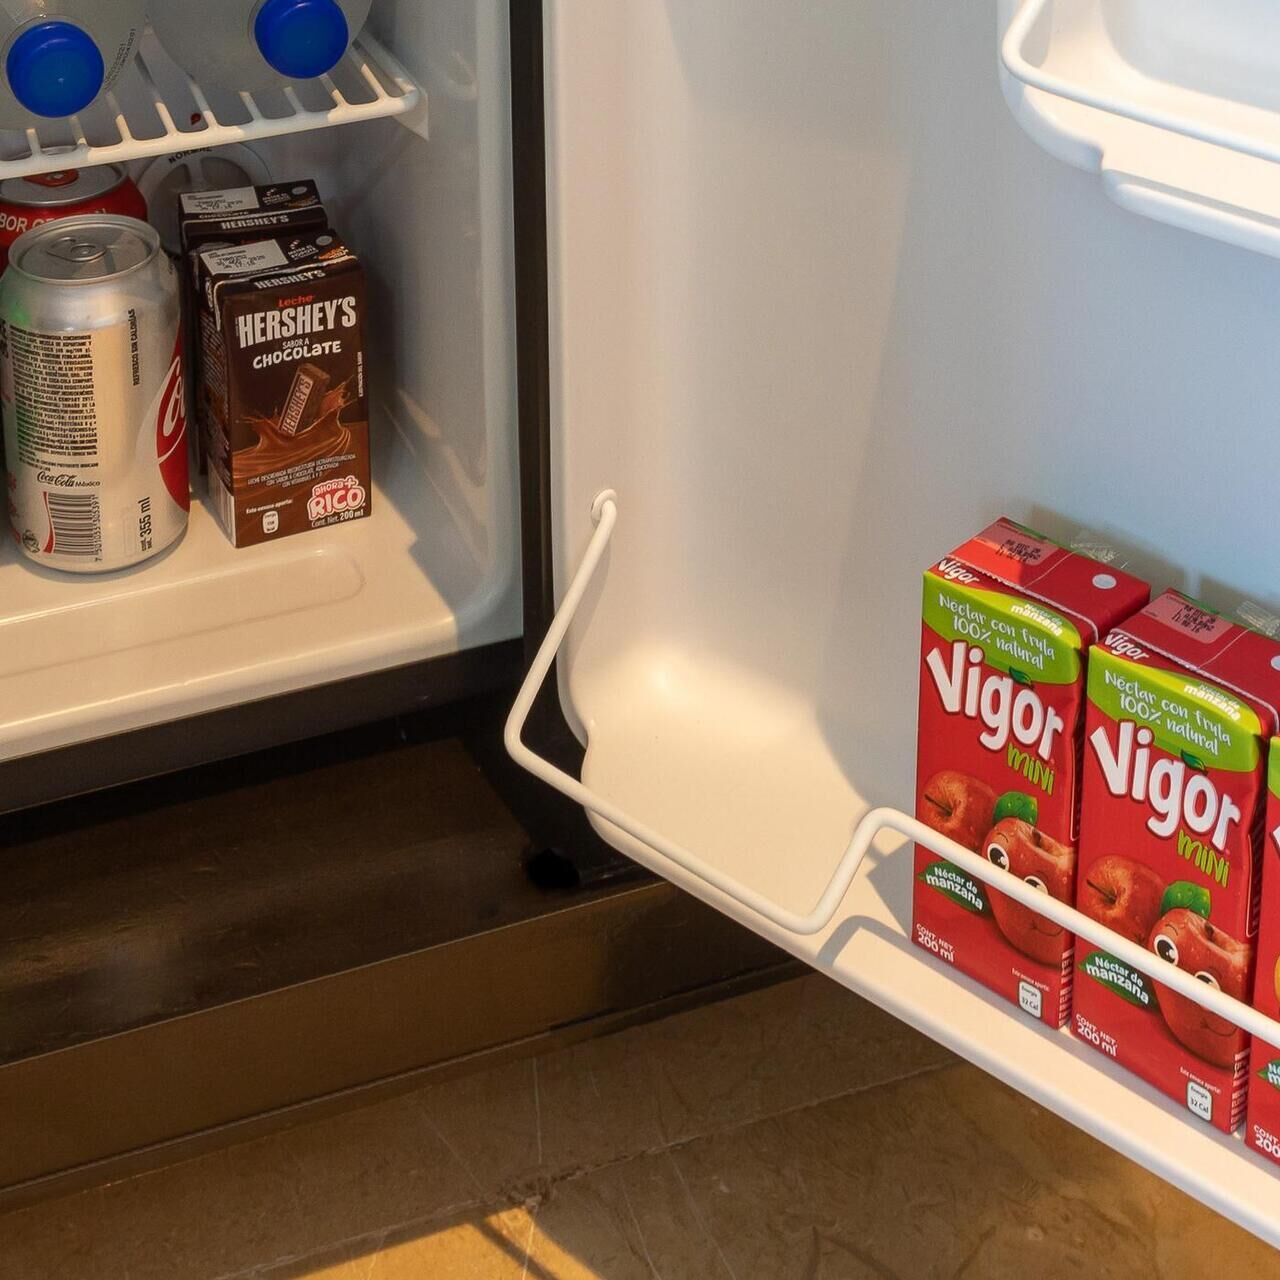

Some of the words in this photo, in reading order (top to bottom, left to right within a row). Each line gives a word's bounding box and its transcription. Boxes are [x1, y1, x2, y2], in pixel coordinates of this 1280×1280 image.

[220, 214, 290, 230] HERSHEY'S
[253, 269, 327, 289] HERSHEY'S
[278, 294, 315, 308] Leche
[238, 296, 357, 349] HERSHEY'S
[282, 338, 304, 350] SABOR
[304, 337, 310, 345] A
[138, 496, 151, 512] ml
[310, 487, 365, 518] RICO
[339, 511, 353, 521] 200
[354, 509, 364, 519] ml
[139, 518, 152, 538] 355
[938, 558, 981, 585] Vigor
[952, 615, 993, 644] 100%
[996, 637, 1044, 671] natural
[990, 619, 1016, 638] con
[1104, 634, 1150, 661] Vigor
[926, 641, 1065, 762] Vigor
[1104, 669, 1157, 705] Néctar
[1161, 697, 1189, 720] con
[1119, 693, 1164, 726] 100%
[1166, 719, 1219, 756] natural
[1090, 722, 1242, 852] Vigor
[925, 873, 984, 912] manzana
[933, 866, 965, 886] Néctar
[966, 881, 978, 895] de
[918, 931, 939, 953] 200
[940, 947, 956, 963] ml
[1086, 963, 1150, 1005] manzana
[1094, 956, 1129, 977] Néctar
[1130, 973, 1144, 988] de
[1077, 1022, 1100, 1045] 200
[1101, 1040, 1118, 1057] ml
[1255, 1133, 1280, 1158] 200
